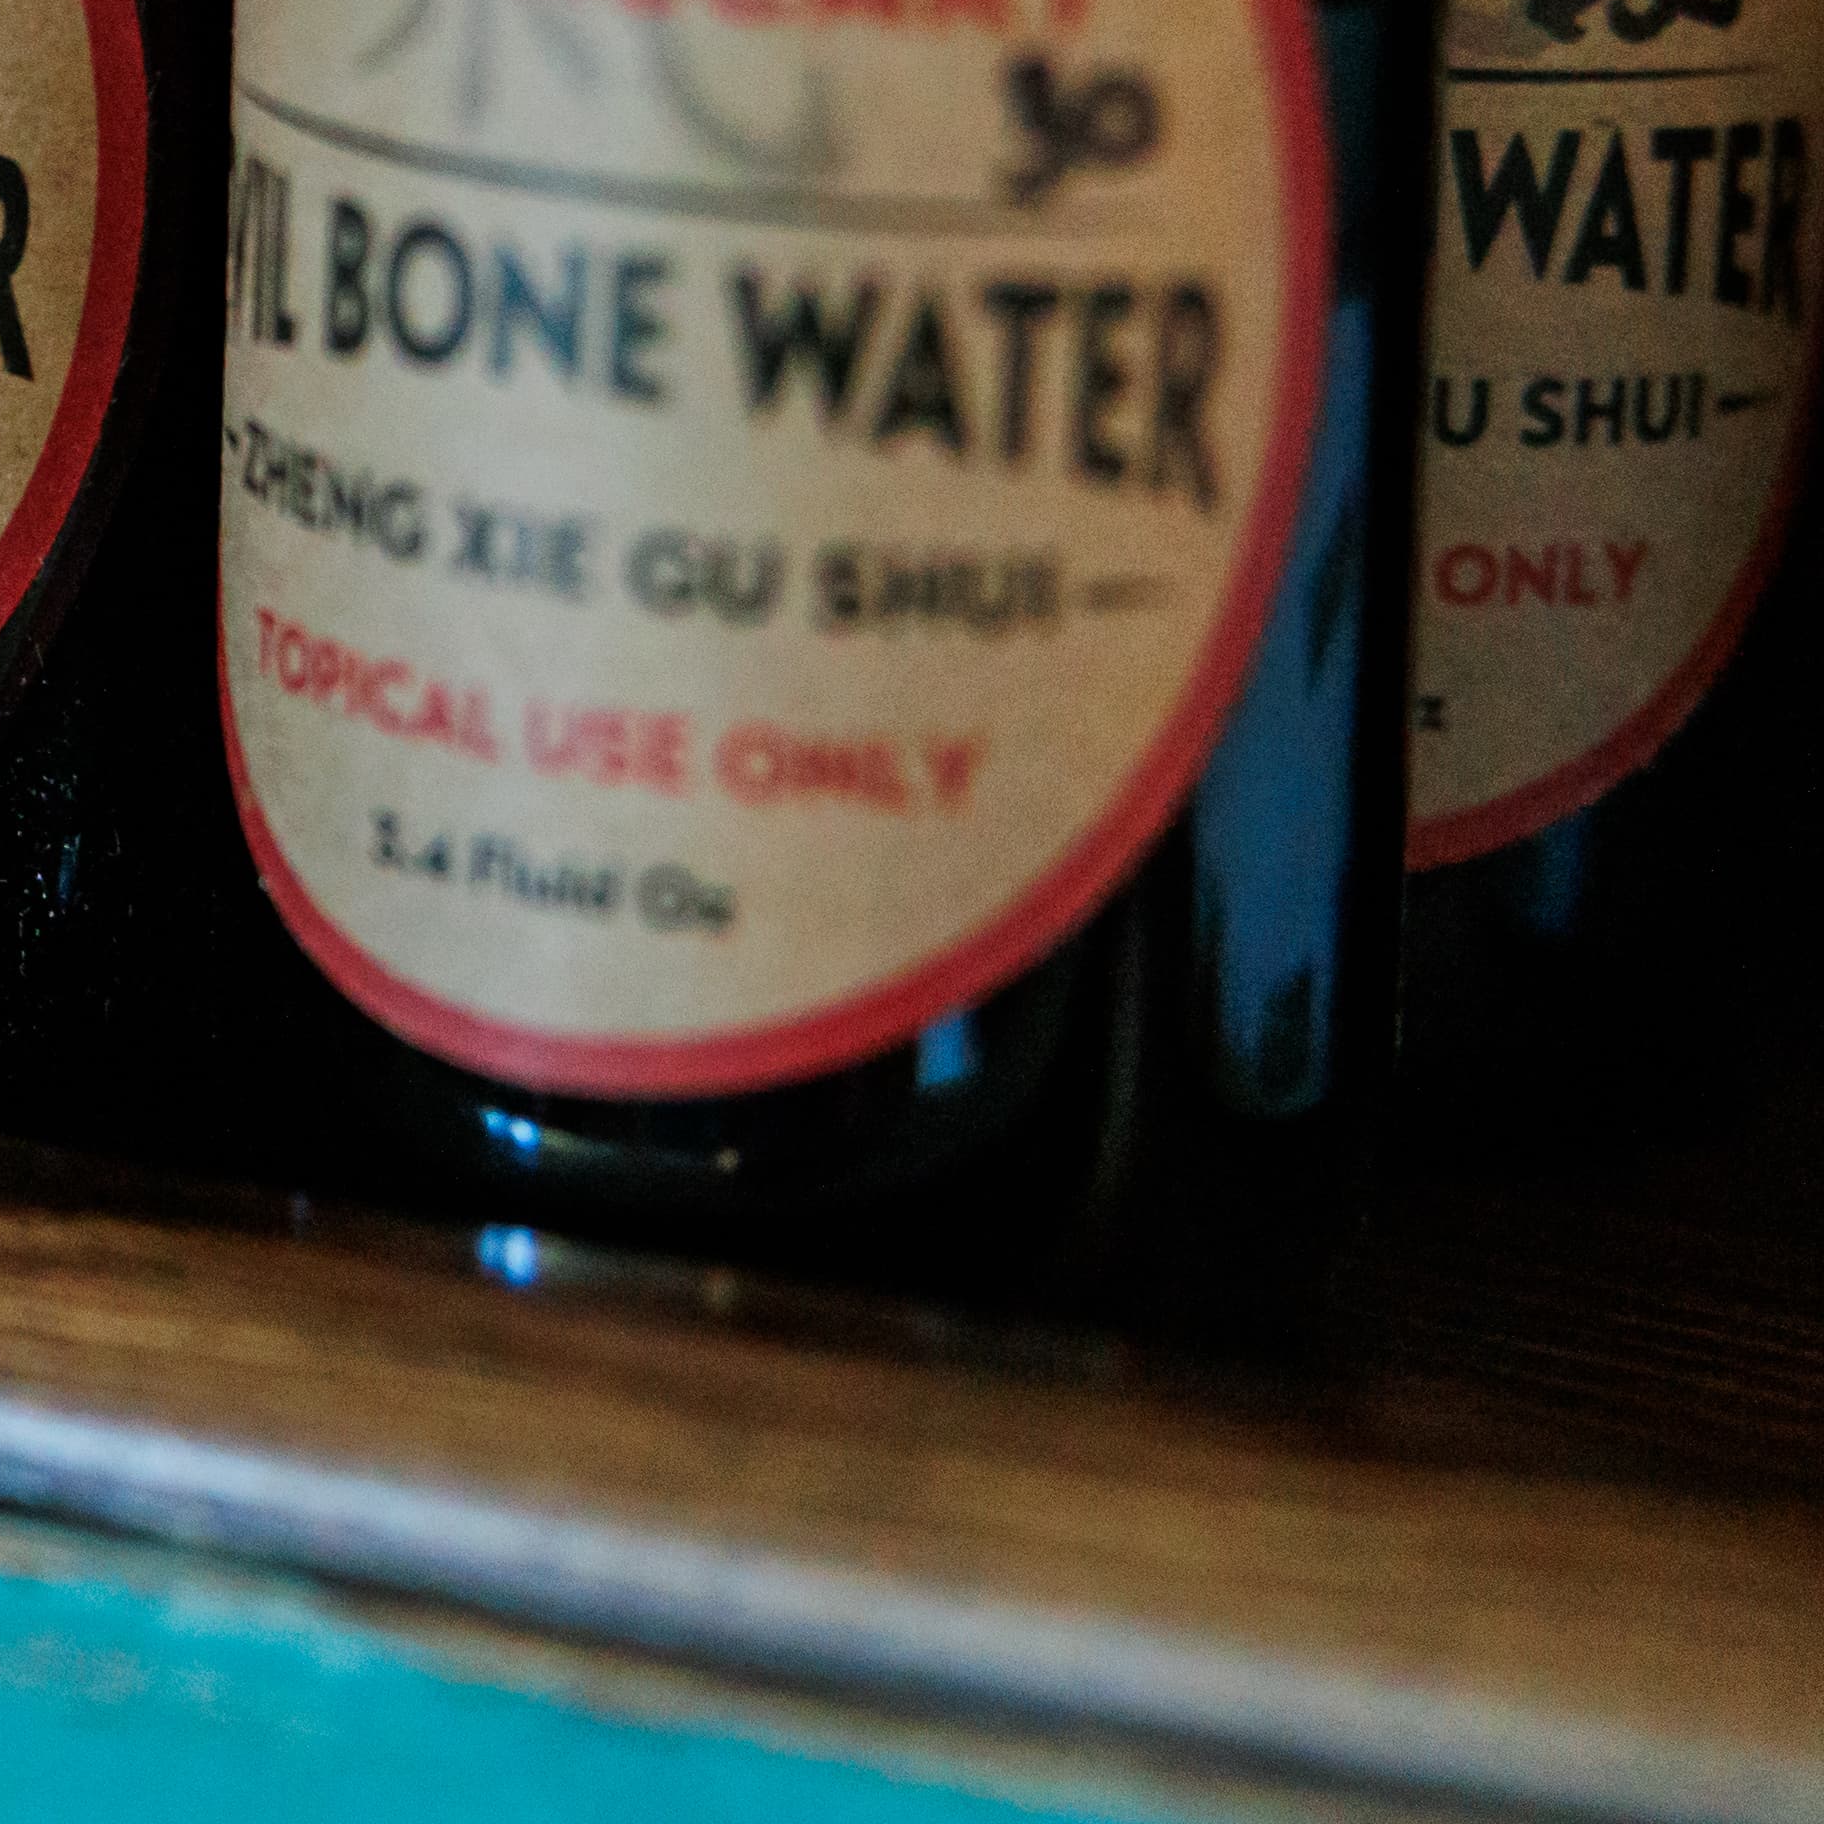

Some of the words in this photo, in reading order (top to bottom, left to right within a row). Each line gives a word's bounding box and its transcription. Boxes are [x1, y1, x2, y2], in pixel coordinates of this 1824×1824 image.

[1450, 117, 1804, 324] WATER
[320, 194, 674, 404] BONE
[730, 260, 1224, 514] WATER
[622, 522, 786, 630] GU
[1433, 538, 1649, 608] ONLY
[254, 604, 502, 770] TOPICAL
